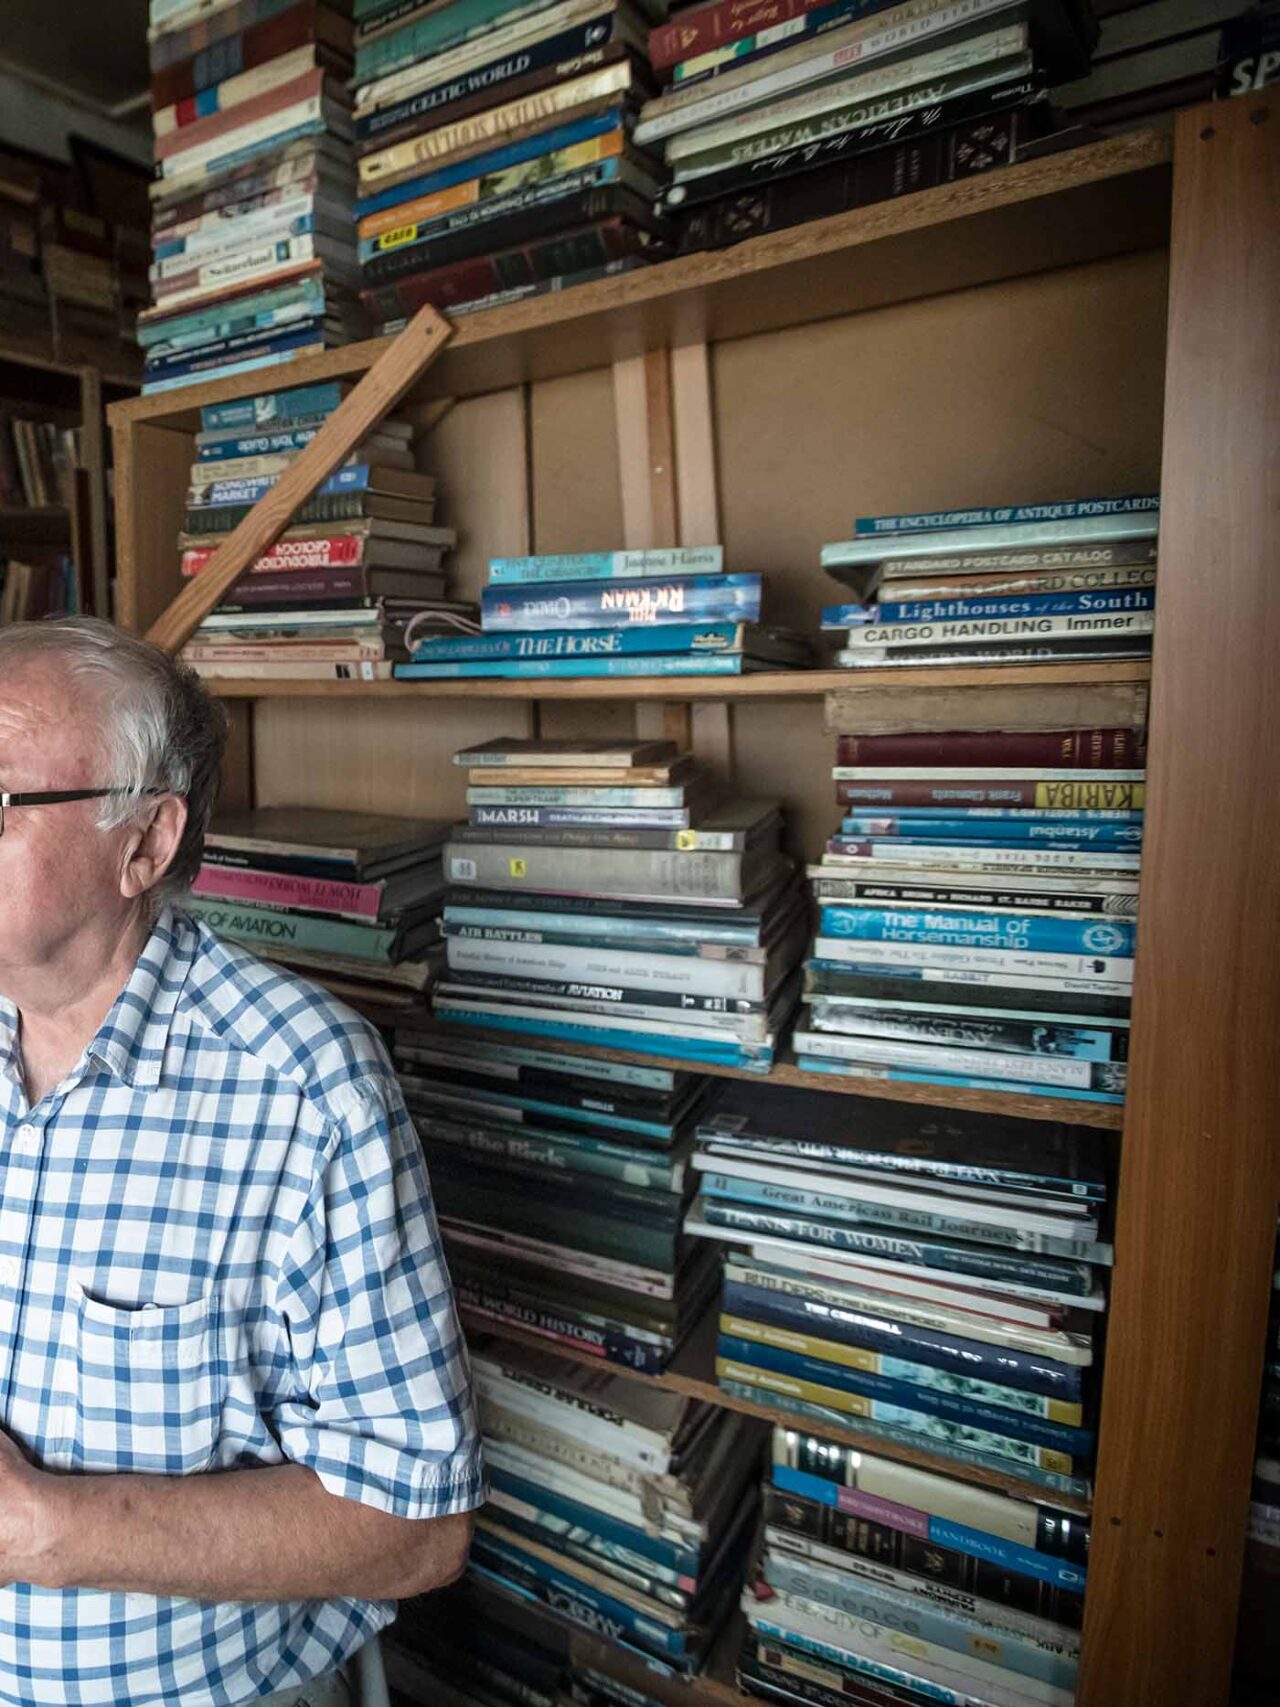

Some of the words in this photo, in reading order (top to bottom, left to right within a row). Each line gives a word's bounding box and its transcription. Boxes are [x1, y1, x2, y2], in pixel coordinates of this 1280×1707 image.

[410, 83, 468, 113] CELTIC
[468, 54, 531, 92] WORLD
[820, 81, 949, 135] AMERICAN
[730, 120, 817, 161] WATERS
[237, 434, 269, 452] Guide
[268, 431, 295, 449] York
[874, 518, 898, 531] THE
[993, 508, 1013, 523] OF
[1014, 503, 1076, 521] ANTIQUE
[1077, 496, 1161, 514] POSTCARDS
[671, 551, 716, 566] Harris
[886, 557, 961, 573] STANDARD
[962, 553, 1041, 570] POSTCARD
[1042, 548, 1114, 565] CATALOG
[600, 584, 685, 612] RICKMAN
[897, 601, 1031, 622] Lighthouses
[1077, 593, 1149, 612] South
[863, 624, 934, 643] CARGO
[941, 618, 1053, 638] HANDLING
[1067, 613, 1136, 632] Immer
[517, 637, 554, 656] THE
[555, 633, 623, 653] HORSE
[1044, 782, 1134, 808] KARIBA
[484, 809, 540, 824] MARSH
[210, 910, 229, 927] OF
[230, 914, 299, 940] AVIATION
[458, 926, 483, 939] AIR
[484, 928, 543, 944] BATTLES
[882, 911, 920, 929] The
[923, 914, 1000, 934] Manual
[882, 928, 1029, 950] Horsemanship
[567, 984, 625, 1002] AVIATION
[761, 1185, 806, 1205] Great
[809, 1190, 893, 1220] American
[897, 1206, 936, 1226] Rail
[939, 1216, 1025, 1245] Journeys
[723, 1211, 791, 1232] TENNIS
[793, 1220, 838, 1242] FOR
[843, 1228, 924, 1258] WOMEN
[483, 1297, 538, 1325] WORLD
[539, 1311, 607, 1346] HISTORY
[930, 1523, 1008, 1560] HANDBOOK
[789, 1574, 921, 1635] Science
